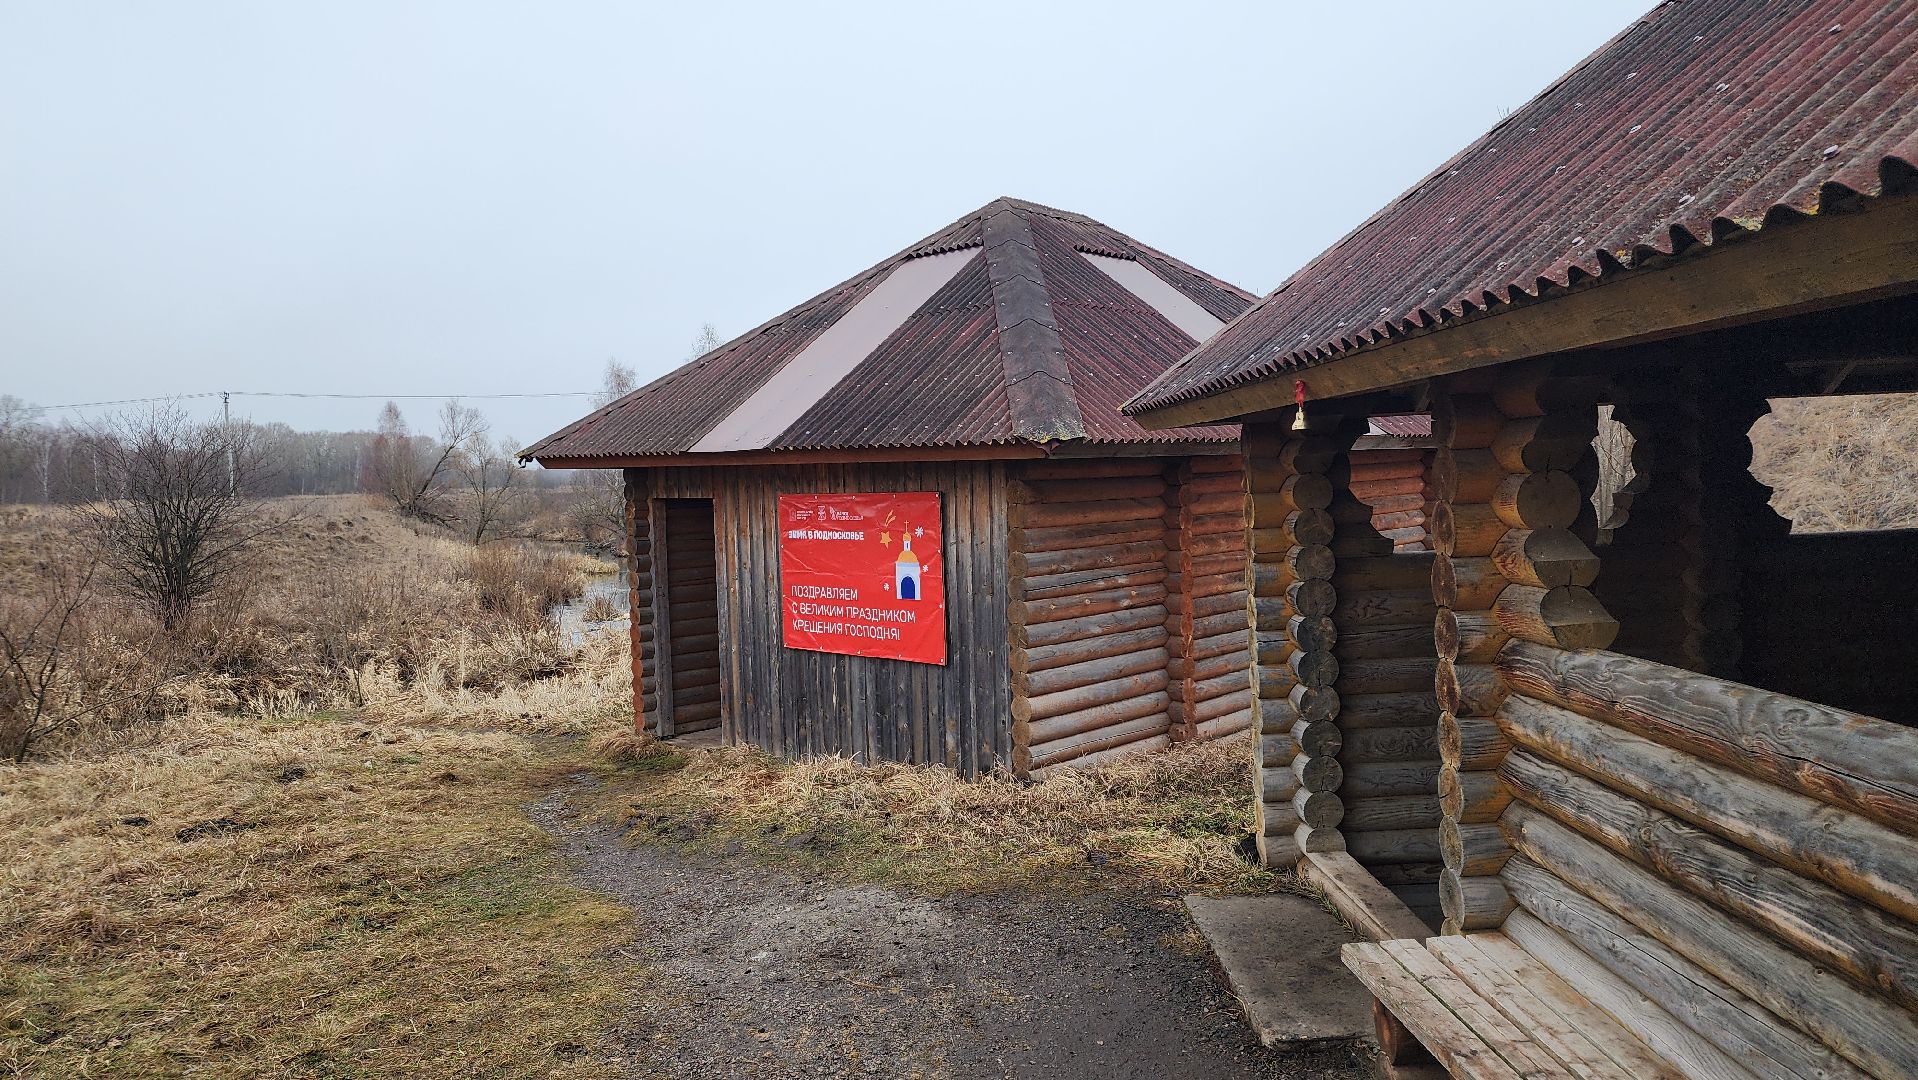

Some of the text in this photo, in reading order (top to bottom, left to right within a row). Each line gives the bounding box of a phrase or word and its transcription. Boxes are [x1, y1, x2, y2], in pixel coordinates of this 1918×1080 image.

[807, 531, 813, 539] В
[814, 530, 865, 540] ПОДМОСКОВЬЕ
[791, 585, 858, 600] ПОЗДРАВЛЯЕМ
[792, 602, 916, 623] С ВЕЛИКИМ ПРАЗДНИКОМ
[792, 619, 900, 640] КРЕЩЕНИЯ ГОСПОДНЯ!
